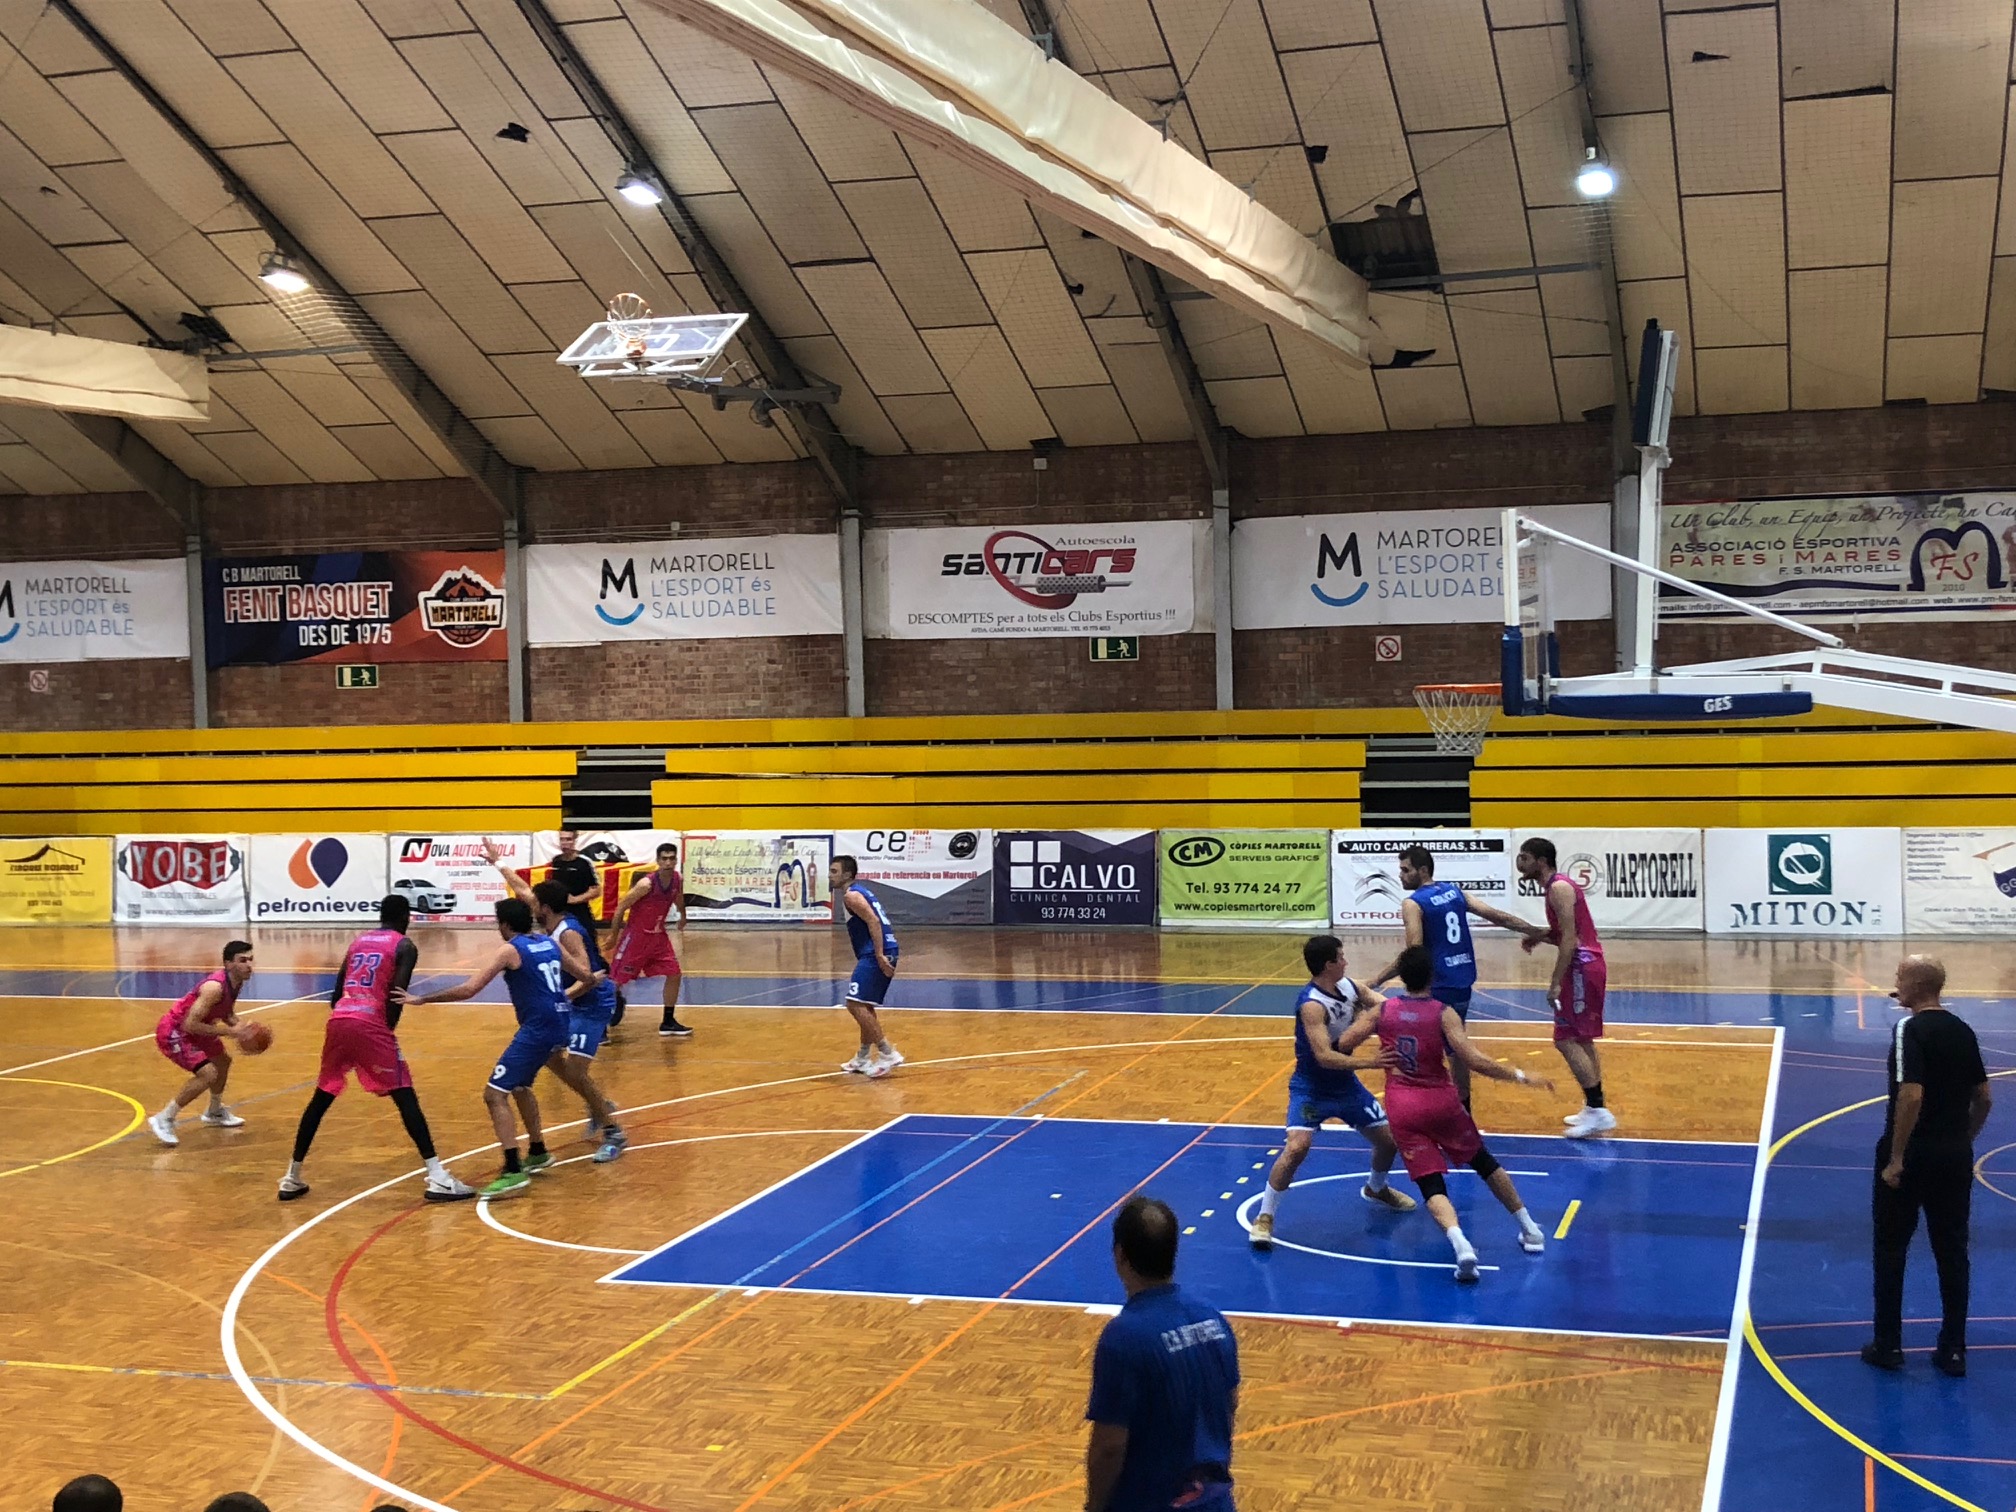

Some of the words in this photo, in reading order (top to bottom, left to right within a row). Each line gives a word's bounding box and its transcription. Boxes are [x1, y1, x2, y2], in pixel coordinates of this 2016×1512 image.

[1056, 535, 1136, 546] Autoescola
[1377, 526, 1503, 549] MARTORE
[1670, 537, 1786, 553] ASSOCIACIÓ
[1793, 536, 1901, 549] ESPORTIVA
[650, 552, 775, 574] MARTORELL
[1378, 553, 1490, 575] L'ESPORT
[1670, 553, 1767, 567] PARES
[1795, 550, 1901, 564] MARES
[241, 565, 301, 582] MARTORELL
[1811, 564, 1902, 574] MARTORELL
[25, 576, 131, 596] MARTORELL
[652, 577, 744, 598] L'ESPORT
[752, 576, 771, 592] és
[1378, 577, 1505, 599] SALUDABL
[26, 598, 107, 617] L'ESPORT
[224, 586, 283, 622] FENT
[286, 581, 393, 620] BASQUET
[653, 597, 776, 619] SALUDABLE
[431, 604, 498, 622] MARTORELL
[907, 612, 994, 625] DESCOMPTES
[997, 613, 1016, 626] per
[1027, 613, 1048, 623] tots
[1050, 611, 1065, 622] els
[1068, 610, 1102, 622] Clubs
[1106, 609, 1162, 623] Esportius
[26, 619, 135, 638] SALUDABLE
[299, 625, 328, 646] DES
[331, 624, 350, 645] DE
[355, 622, 392, 645] 1975
[1704, 696, 1733, 713] GES
[452, 844, 516, 857] AUTOEOLA
[1179, 842, 1213, 861] CM
[1230, 841, 1262, 850] CÒPIES
[1264, 842, 1321, 850] MARTORELL
[1350, 842, 1380, 851] AUTO
[132, 846, 227, 884] YOBE
[1274, 854, 1320, 862] GRÀFICS
[1039, 865, 1135, 889] CALVO
[1577, 870, 1591, 887] 5
[1606, 853, 1697, 898] MARTORELL
[1010, 892, 1068, 903] CLÍNICA
[1087, 893, 1141, 903] DENTAL
[1186, 882, 1209, 894] Tel.
[1213, 882, 1230, 894] 93
[1234, 882, 1259, 894] 774
[1263, 882, 1281, 894] 24
[1285, 882, 1302, 894] 77
[258, 896, 381, 916] petronieves
[1041, 907, 1055, 919] 93
[1057, 907, 1075, 919] 774
[1077, 907, 1091, 919] 33
[1093, 907, 1106, 919] 24
[1174, 902, 1316, 913] www.copiesmartorell.com
[1340, 909, 1402, 920] CITROË
[1730, 901, 1867, 928] MITON
[1445, 911, 1461, 944] 8
[345, 953, 382, 987] 23
